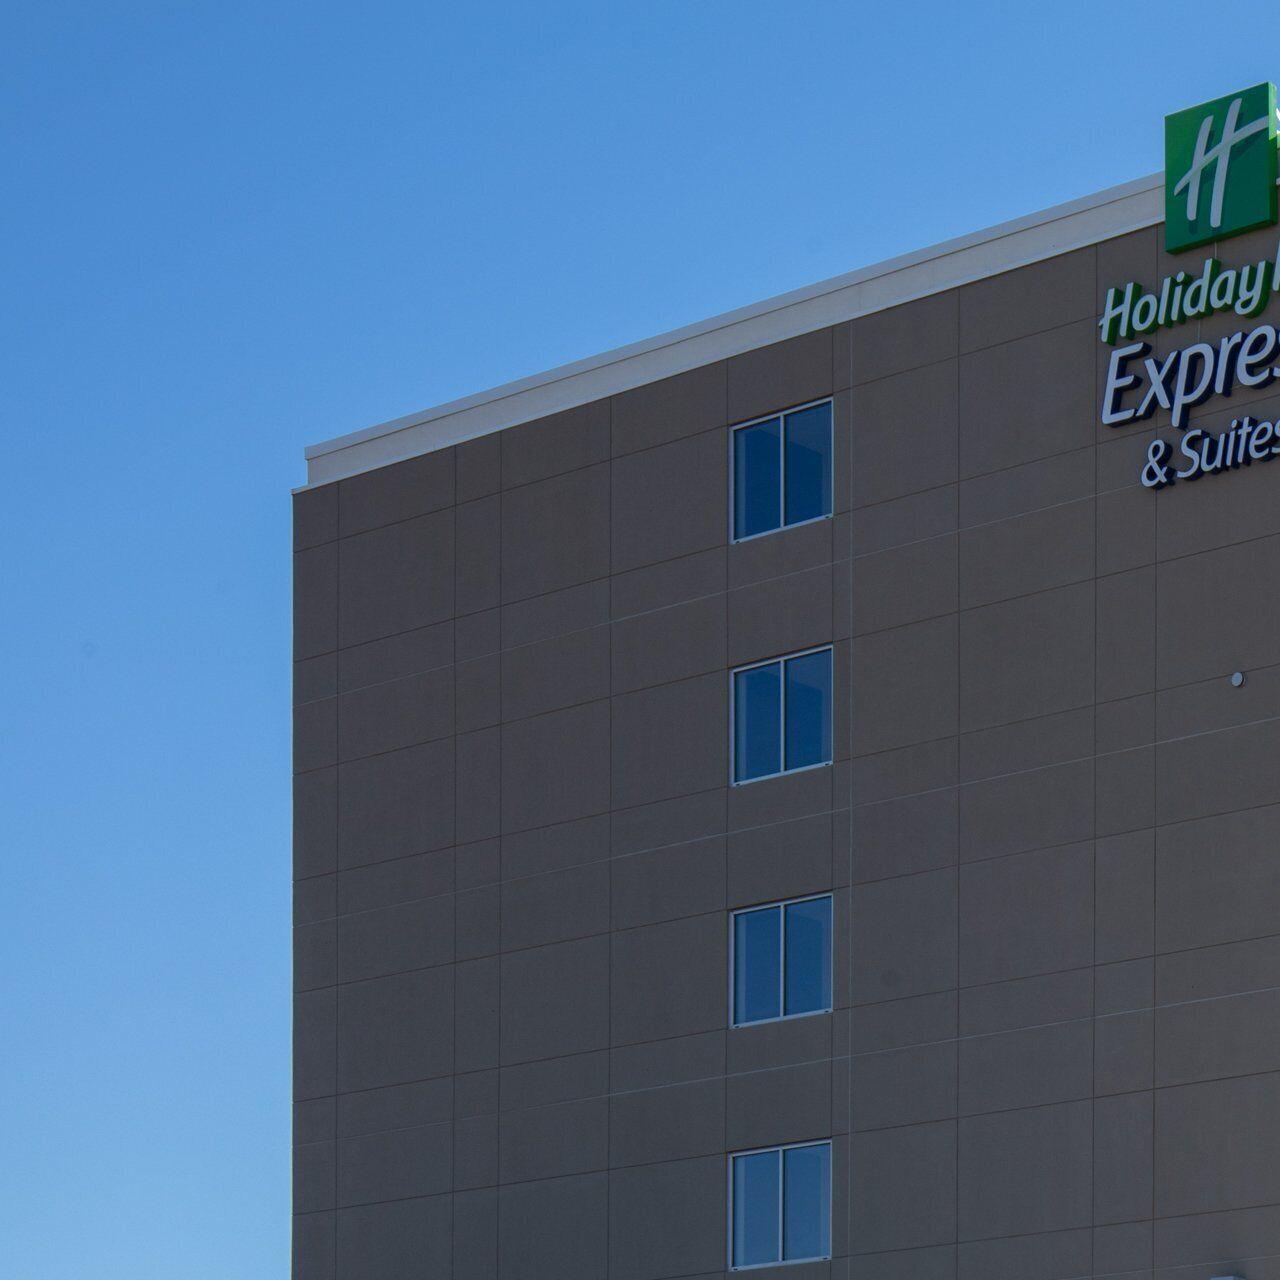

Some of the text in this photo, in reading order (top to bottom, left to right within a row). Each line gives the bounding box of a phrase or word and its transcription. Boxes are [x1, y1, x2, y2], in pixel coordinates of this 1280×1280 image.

[1173, 97, 1269, 228] H
[1098, 257, 1269, 343] Holiday
[1140, 439, 1169, 488] &
